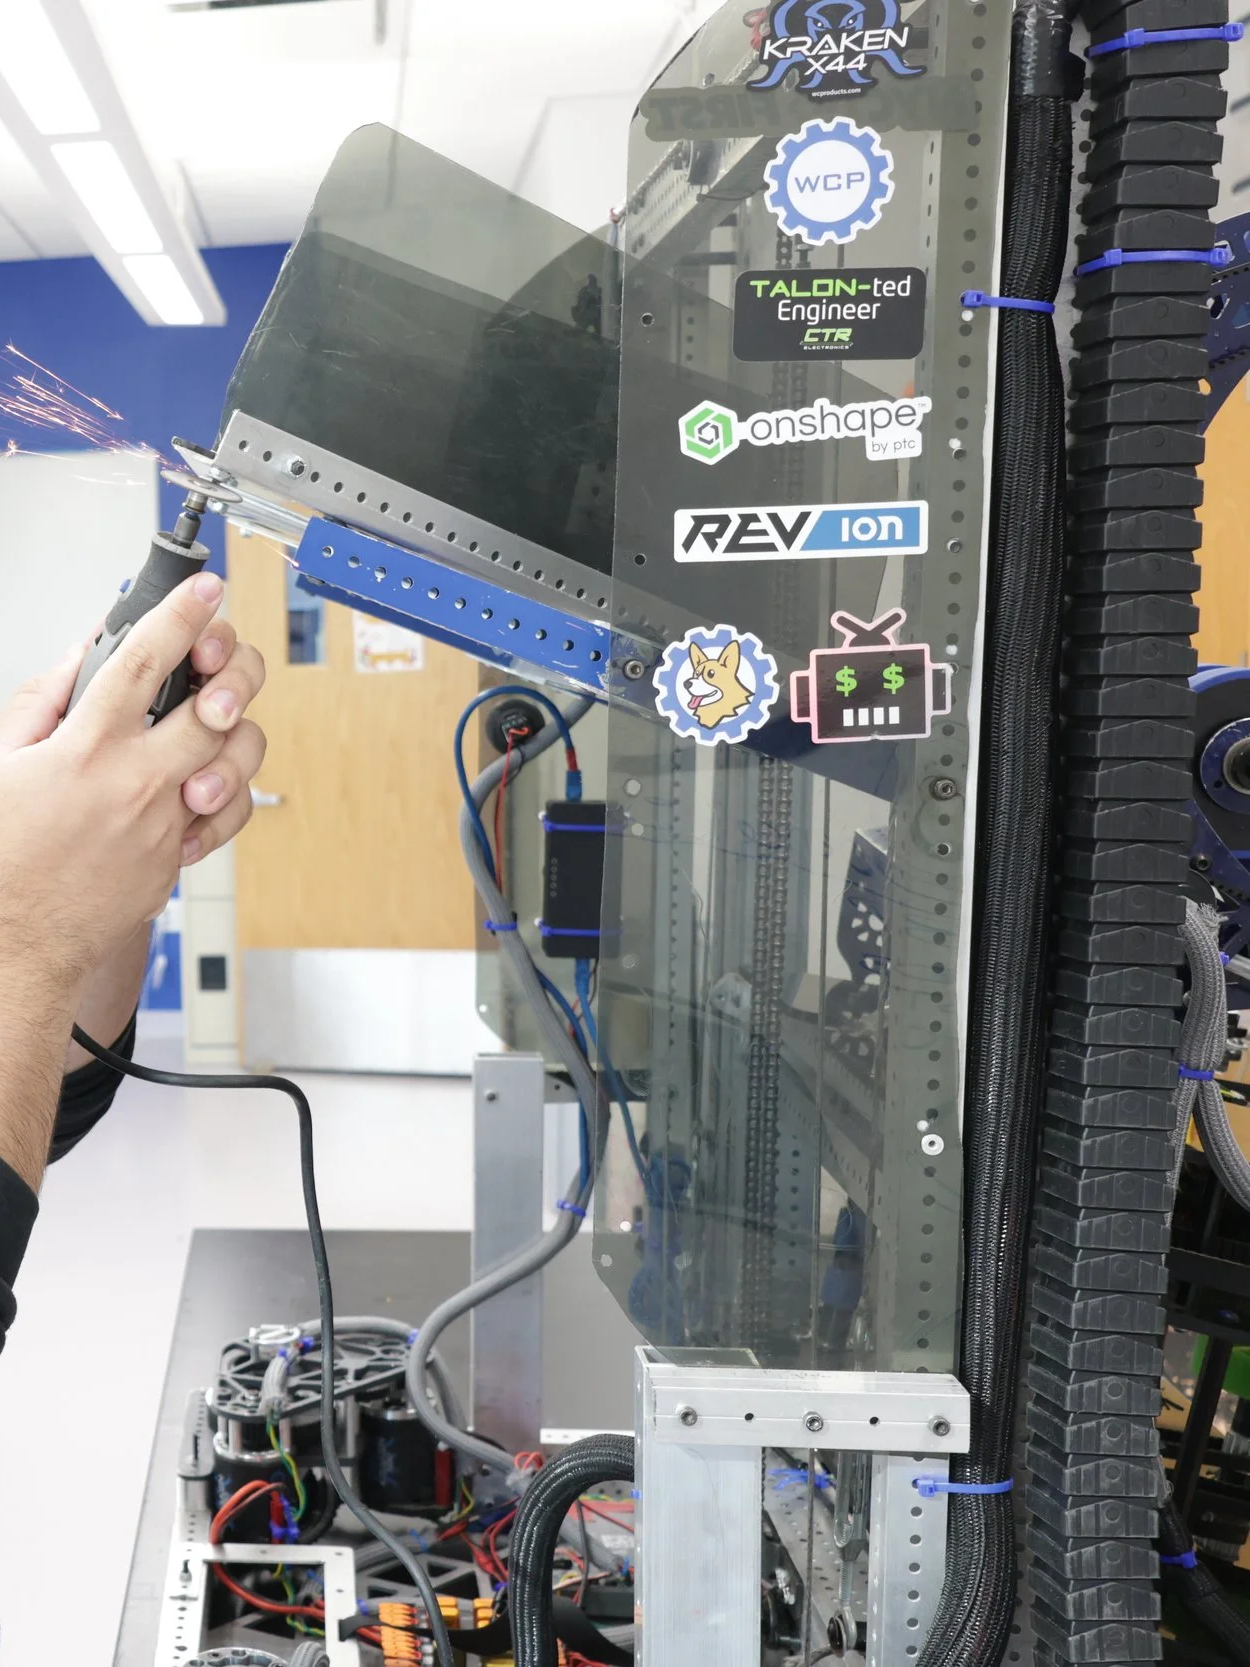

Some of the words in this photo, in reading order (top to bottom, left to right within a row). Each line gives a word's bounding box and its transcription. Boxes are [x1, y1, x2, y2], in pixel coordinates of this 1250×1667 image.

[763, 26, 909, 60] KRAKEN
[804, 53, 868, 76] X44
[811, 87, 861, 98] wcproducts.com
[794, 171, 865, 193] WCP
[750, 275, 911, 298] TALON-ted
[777, 298, 881, 326] Engineer
[803, 328, 852, 342] CTR
[750, 404, 917, 441] onshape
[871, 441, 888, 454] by
[893, 438, 916, 453] ptc
[681, 511, 812, 554] REV
